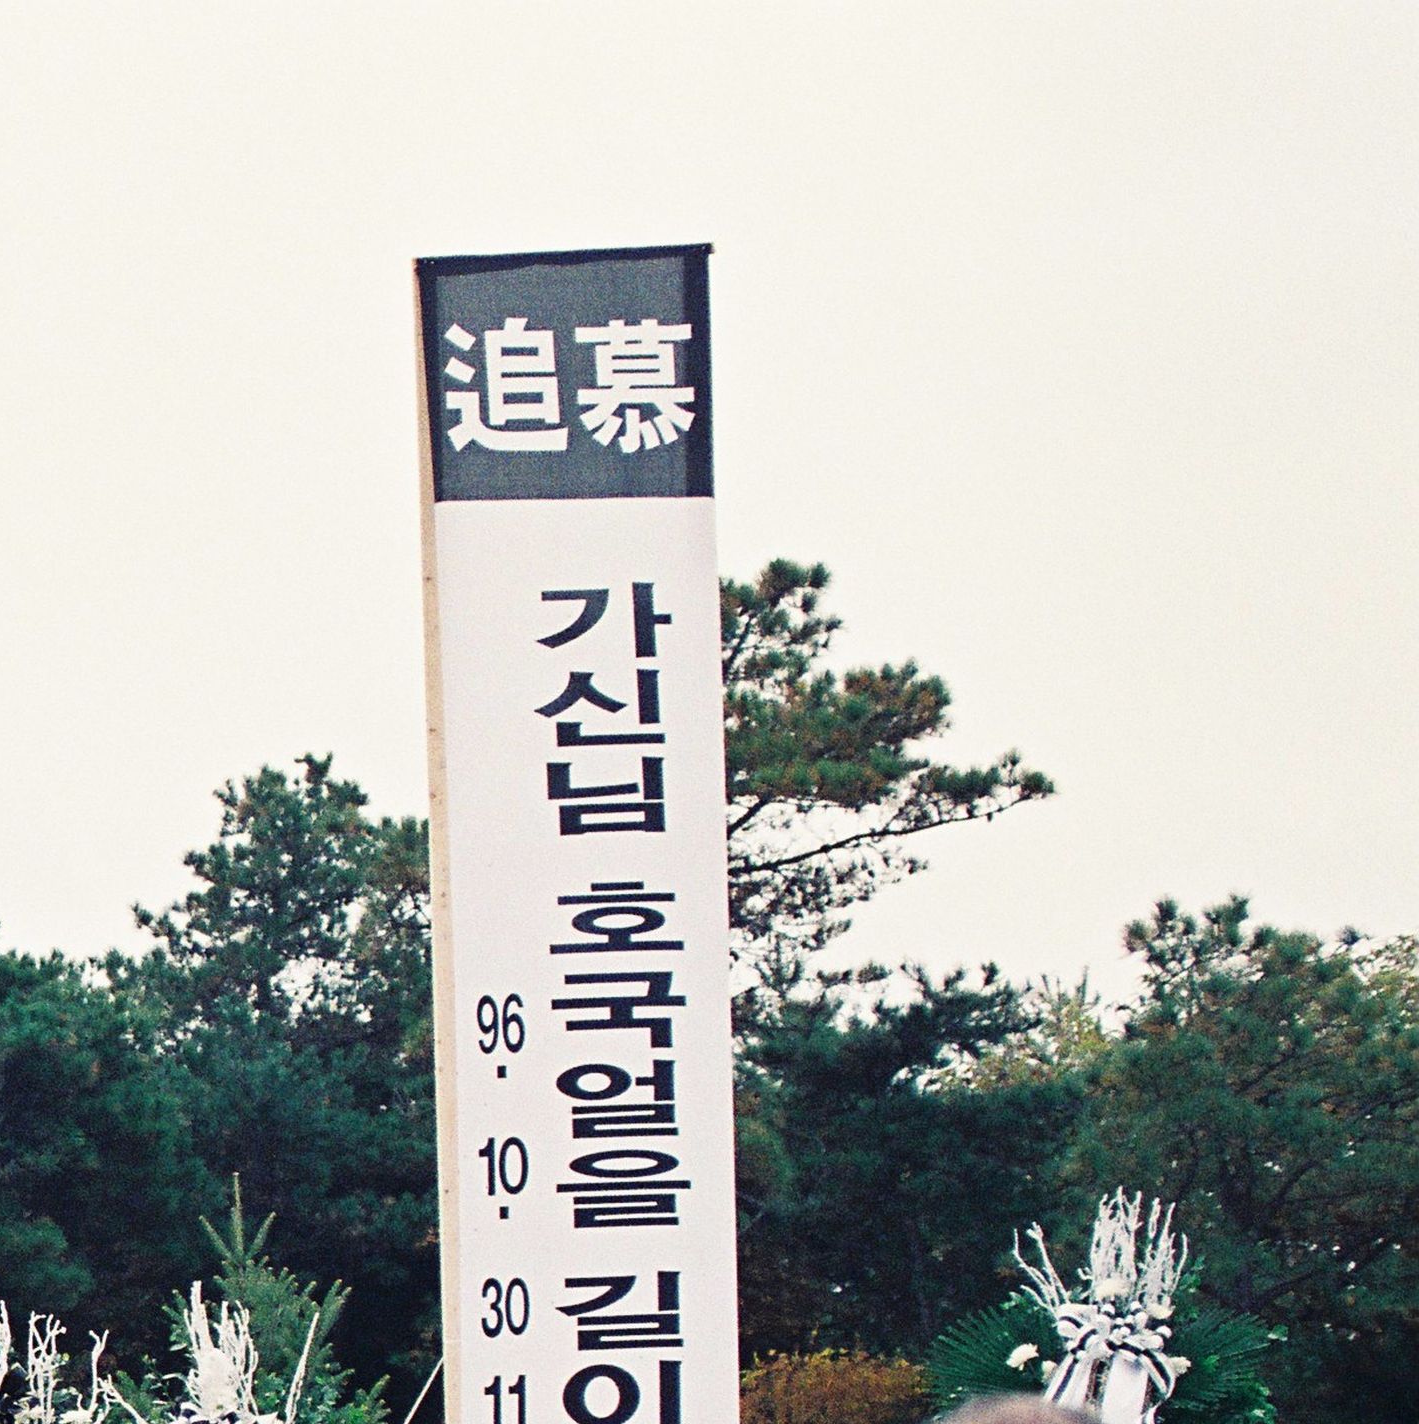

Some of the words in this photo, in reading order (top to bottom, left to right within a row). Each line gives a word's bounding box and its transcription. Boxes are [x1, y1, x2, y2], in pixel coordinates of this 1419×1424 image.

[445, 318, 696, 455] 追慕
[535, 582, 673, 837] 가신님
[549, 881, 692, 1230] 호국얼을
[482, 1278, 531, 1339] 30
